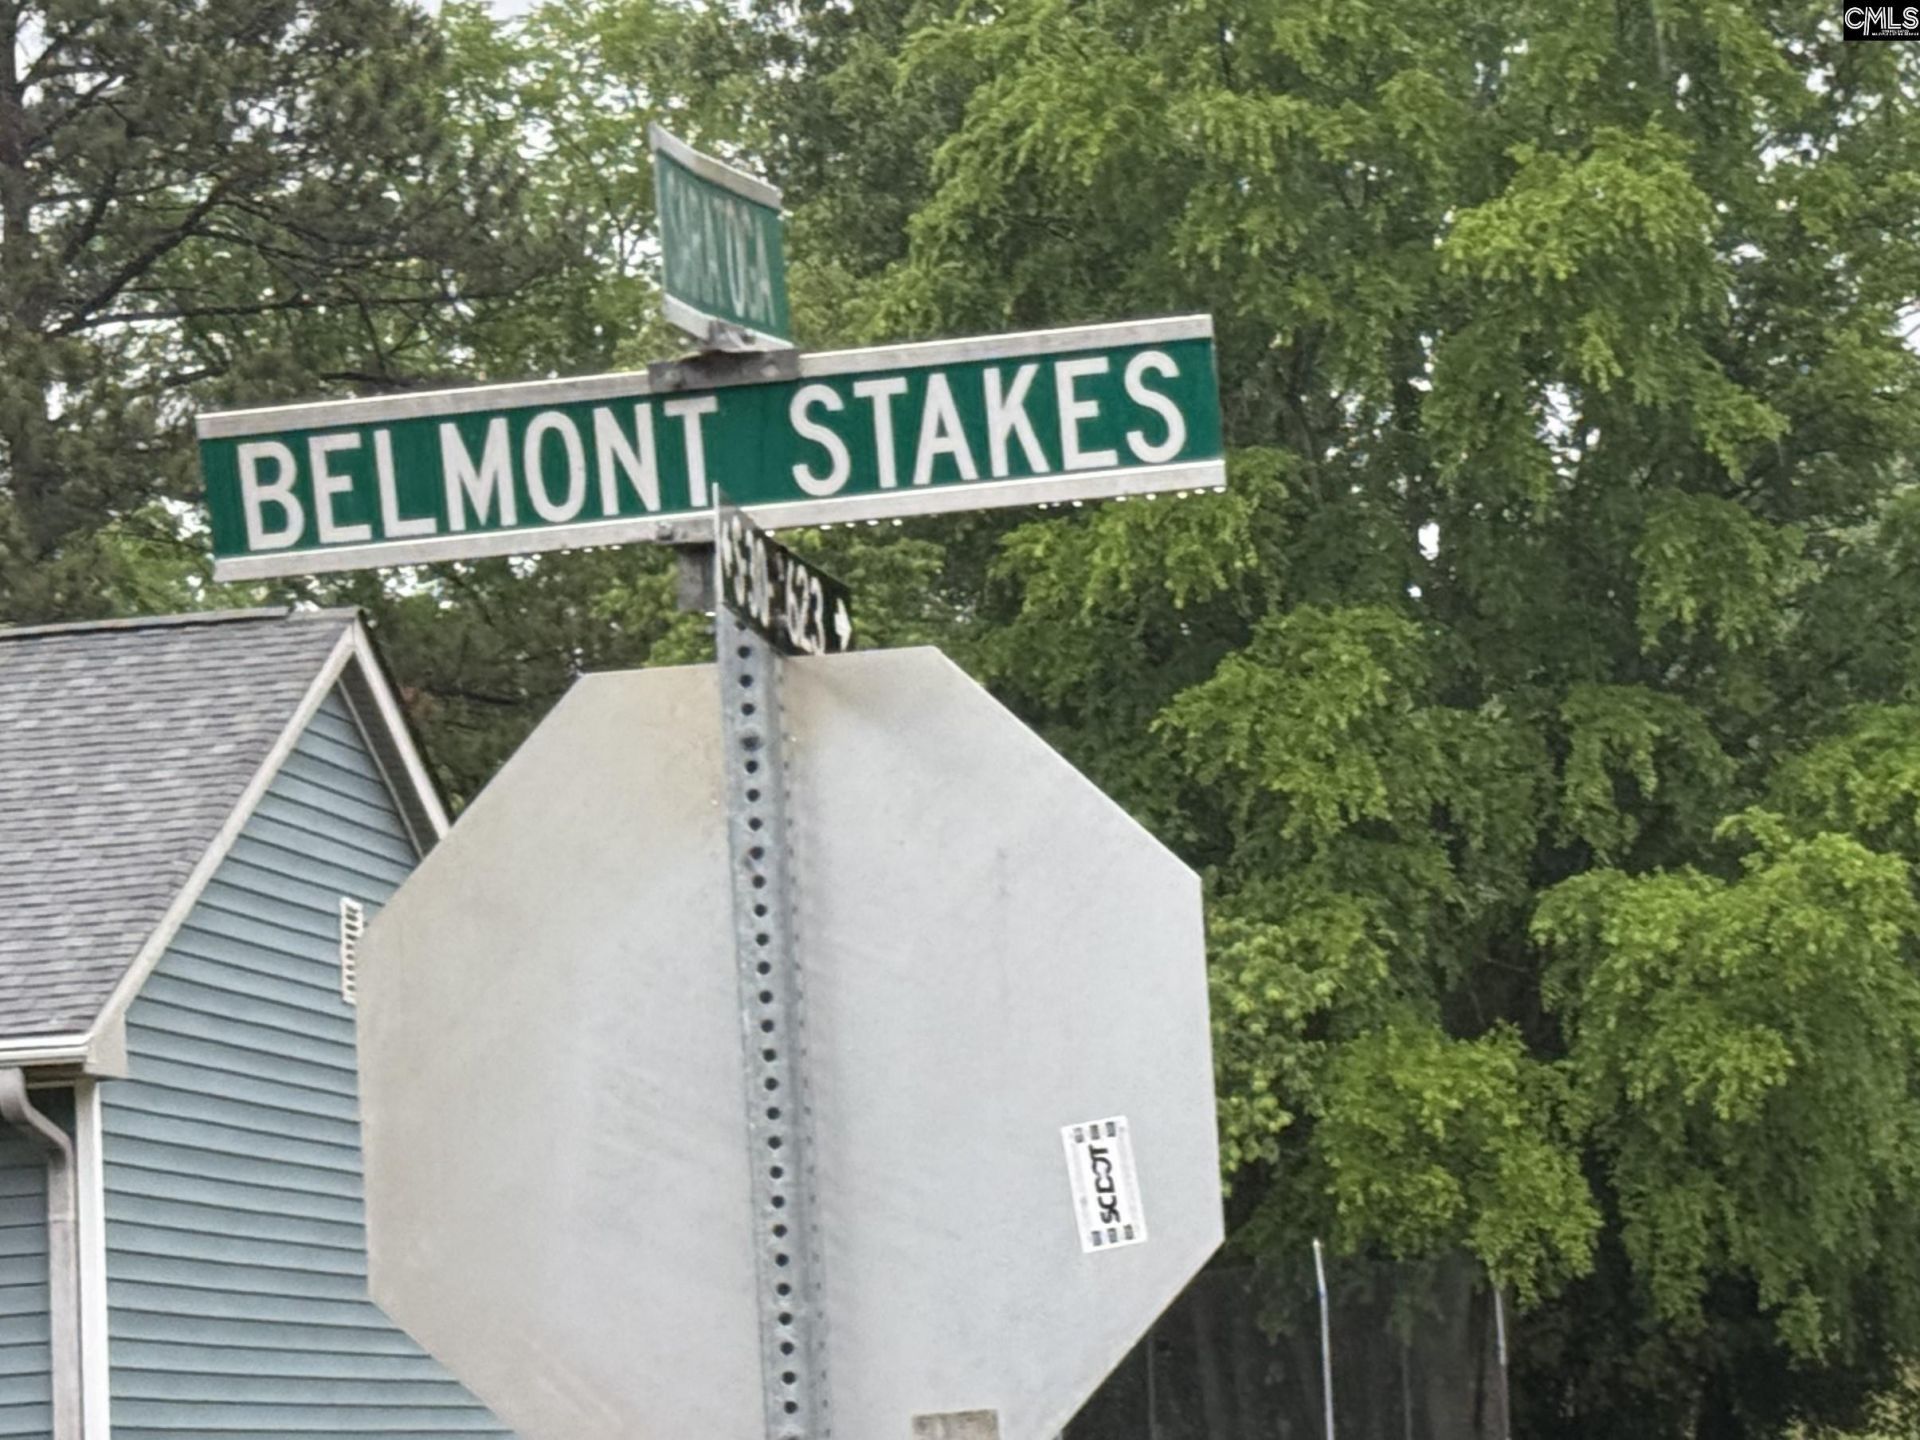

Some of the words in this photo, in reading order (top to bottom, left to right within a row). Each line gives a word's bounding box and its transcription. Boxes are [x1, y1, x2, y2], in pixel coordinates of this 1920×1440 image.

[237, 395, 718, 551] BELMONT
[789, 350, 1187, 496] STAKES
[1088, 1144, 1121, 1224] SCDOT
